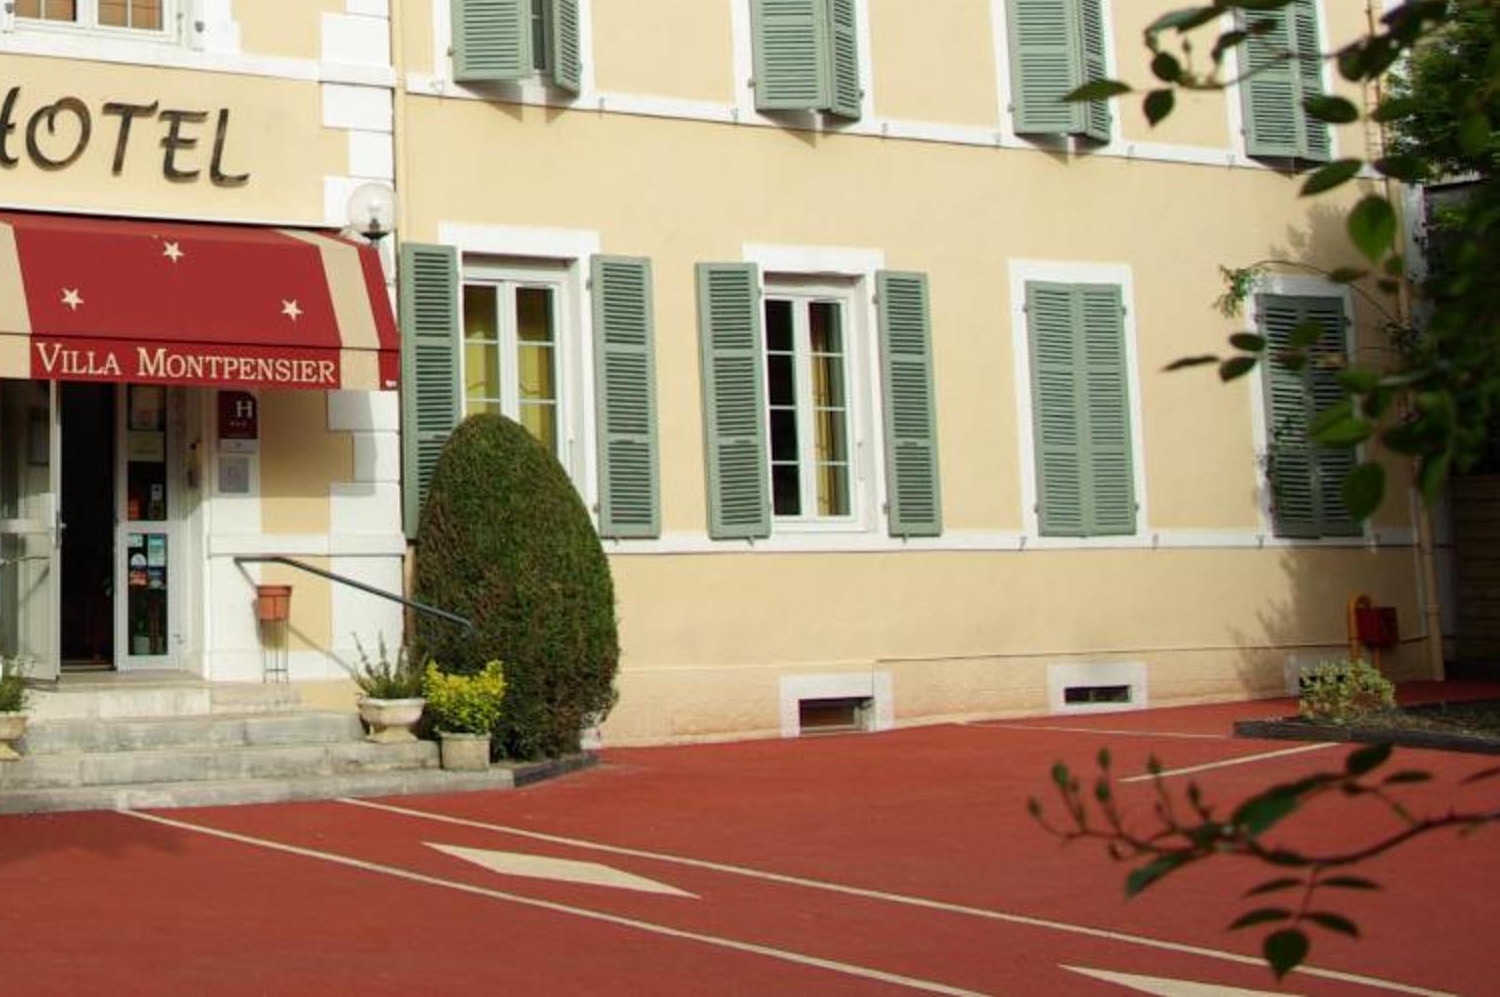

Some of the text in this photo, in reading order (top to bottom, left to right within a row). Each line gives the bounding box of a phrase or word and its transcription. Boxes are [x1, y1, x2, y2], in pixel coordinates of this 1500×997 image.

[35, 342, 337, 383] VILLA MONTPENSIER
[236, 400, 254, 418] H
